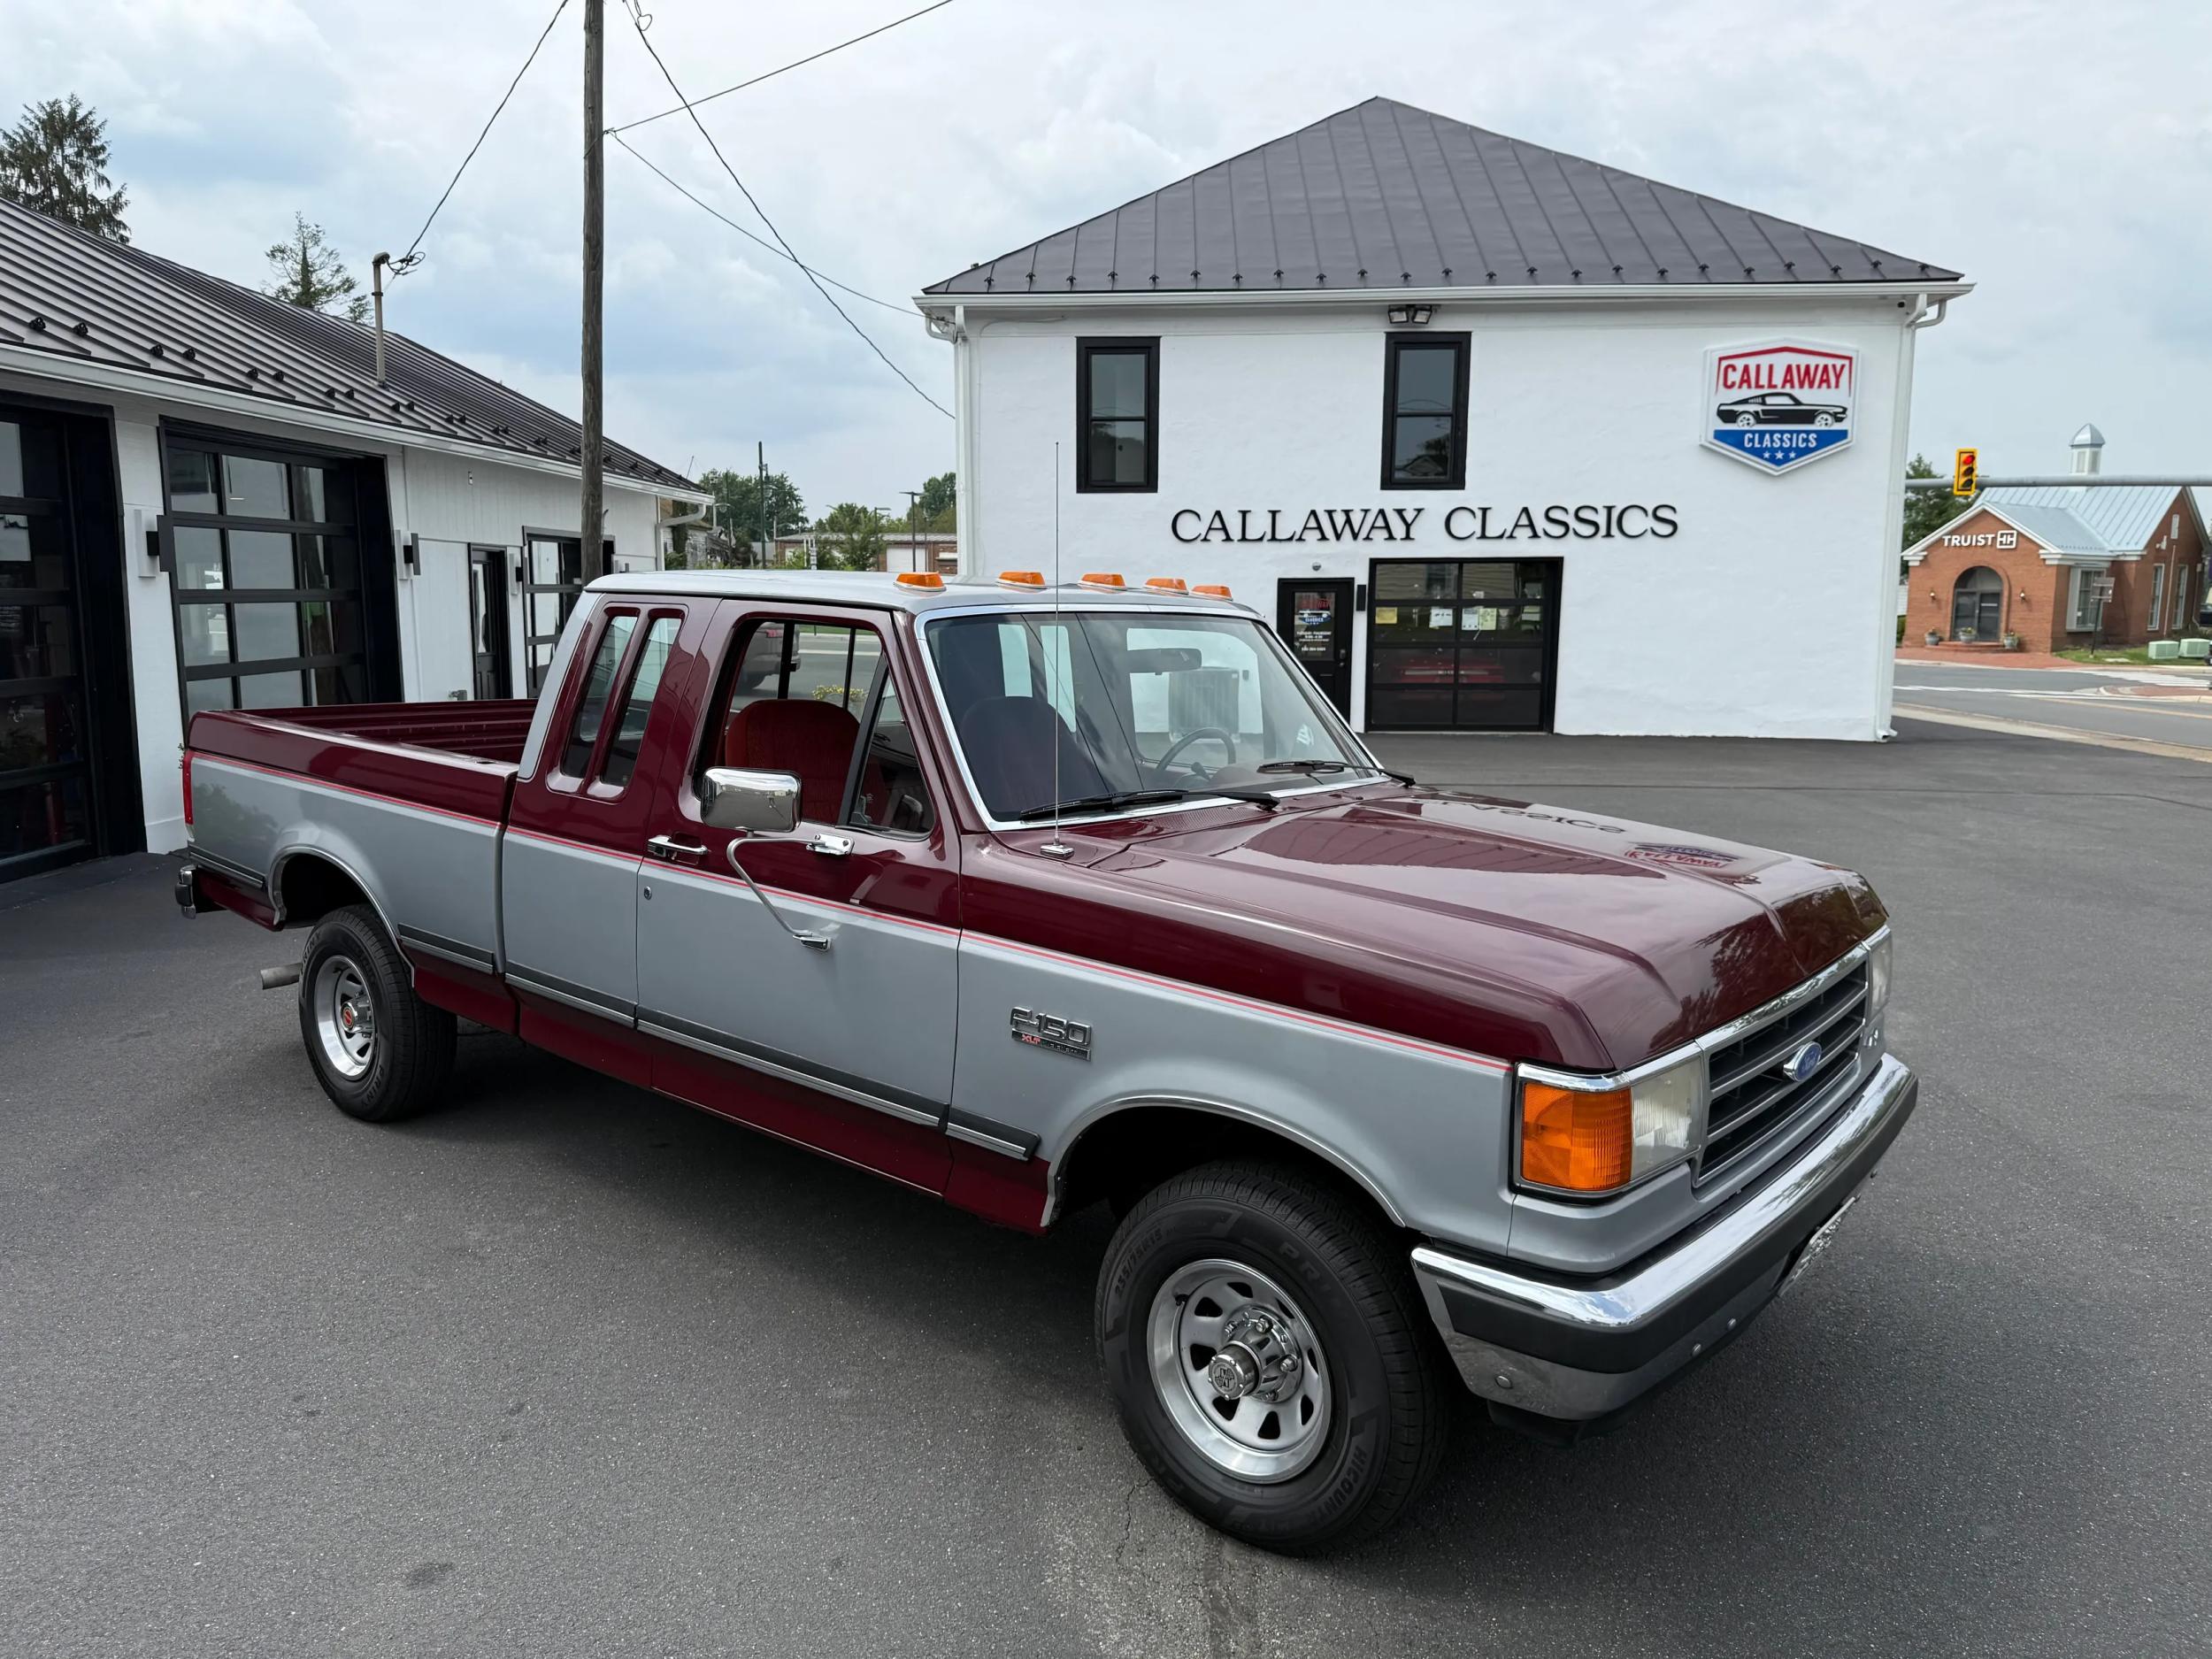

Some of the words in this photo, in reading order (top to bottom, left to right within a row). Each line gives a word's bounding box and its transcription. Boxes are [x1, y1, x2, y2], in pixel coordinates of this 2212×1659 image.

[1722, 364, 1846, 389] CALLAWAY
[1744, 433, 1817, 448] CLASSICS
[1171, 508, 1425, 542] CALLAWAY
[1444, 504, 1678, 540] CLASSICS
[1942, 534, 1995, 547] TRUIST
[1010, 1007, 1092, 1046] F-150
